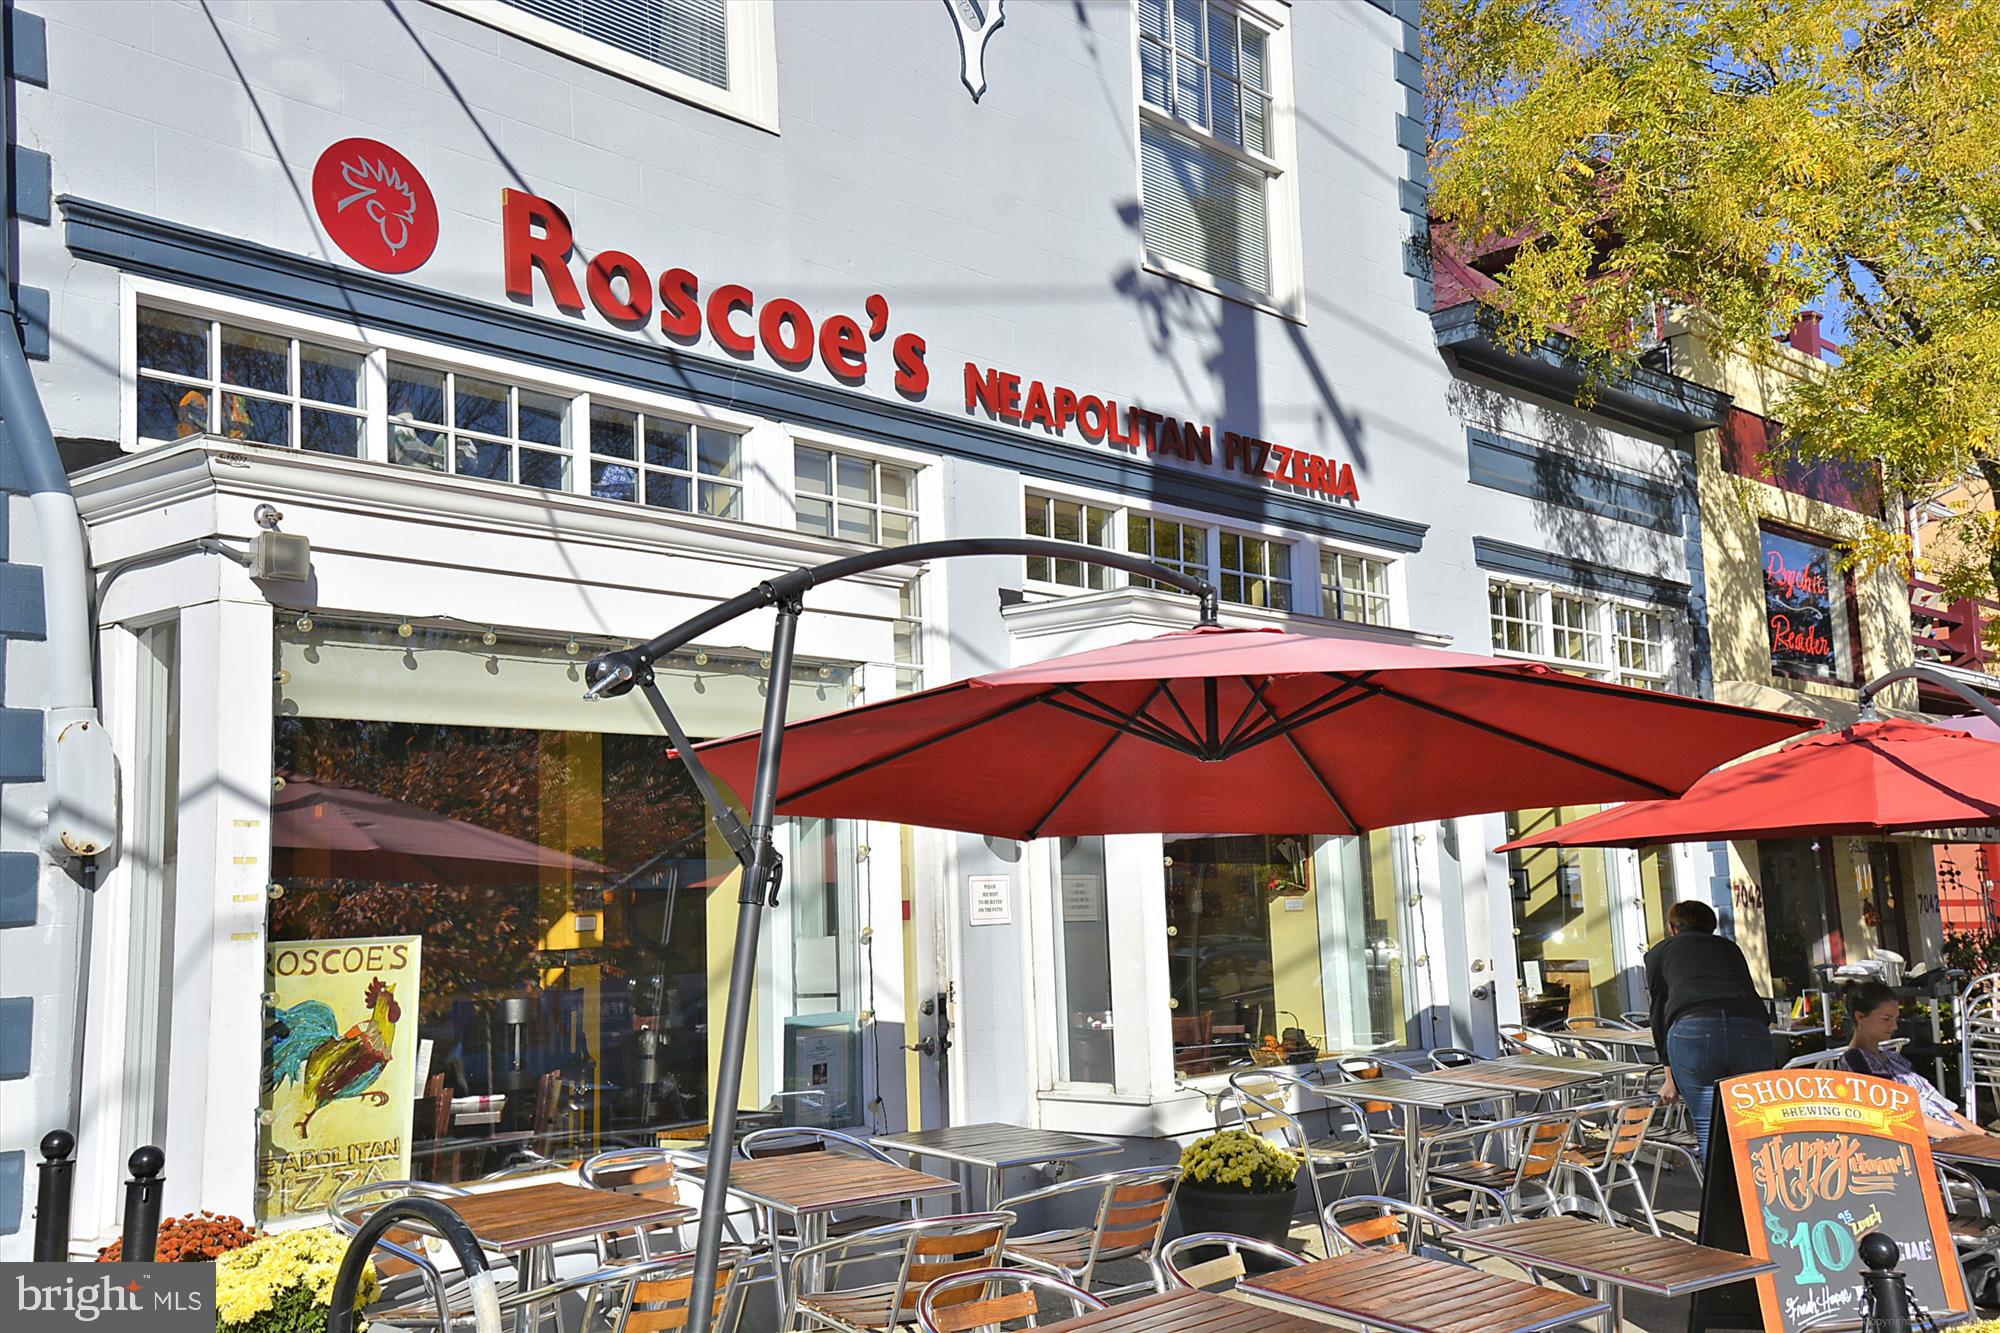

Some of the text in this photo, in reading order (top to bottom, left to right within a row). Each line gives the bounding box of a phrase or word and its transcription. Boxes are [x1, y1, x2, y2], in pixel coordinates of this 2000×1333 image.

[502, 187, 930, 394] Roscoe's
[964, 361, 1361, 501] NEAPOLITAN PIZZERIA
[1767, 551, 1825, 598] Psychic
[1771, 614, 1830, 656] Reader
[1733, 884, 1762, 908] 7042
[1917, 894, 1940, 914] 7042
[1731, 1076, 1838, 1110] SHOCK
[1782, 1105, 1866, 1120] BREWING CO.
[1751, 1134, 1861, 1211] Happy
